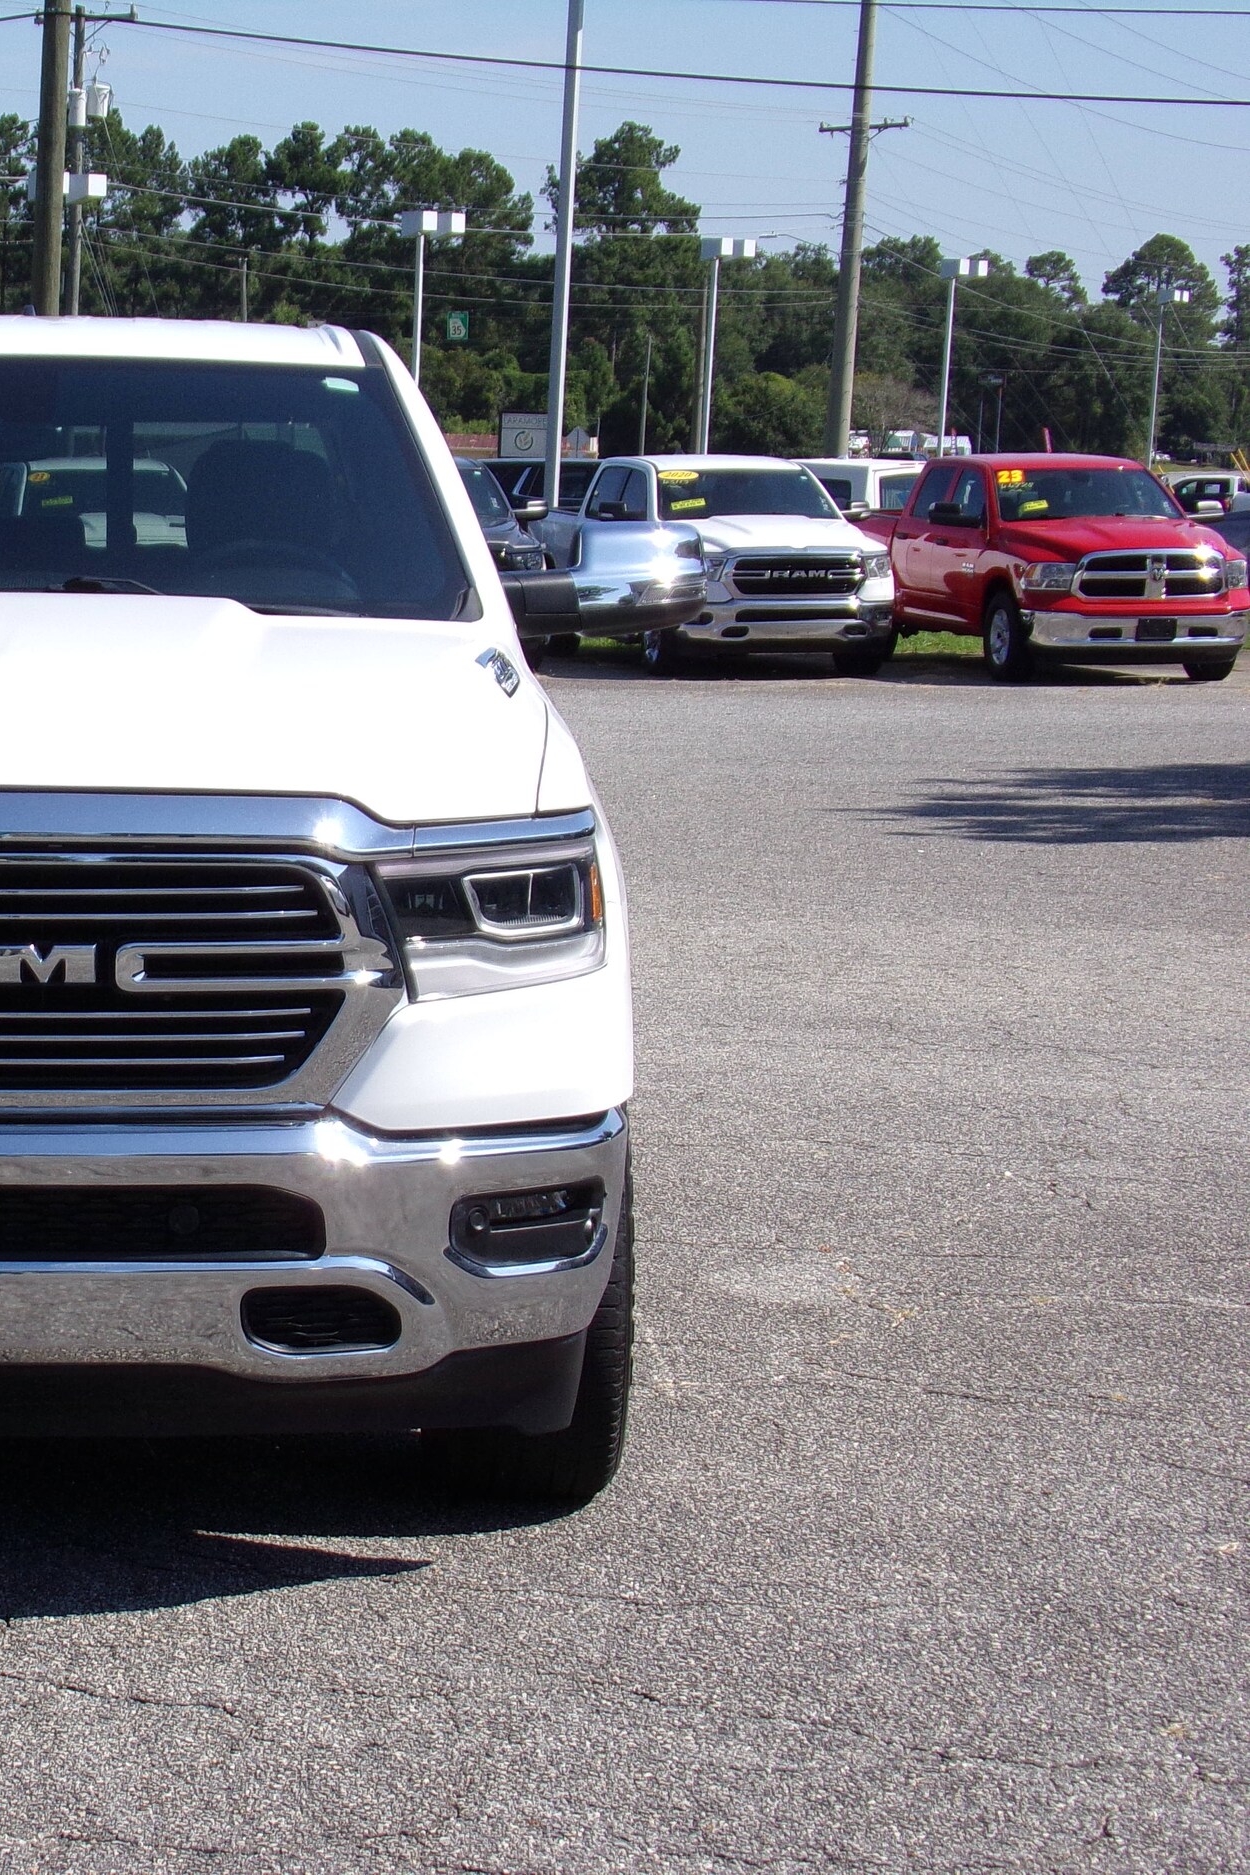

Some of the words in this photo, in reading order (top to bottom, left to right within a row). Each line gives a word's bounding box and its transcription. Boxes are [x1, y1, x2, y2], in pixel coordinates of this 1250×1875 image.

[451, 325, 463, 336] 35
[997, 469, 1023, 484] 23
[772, 569, 826, 579] RAM
